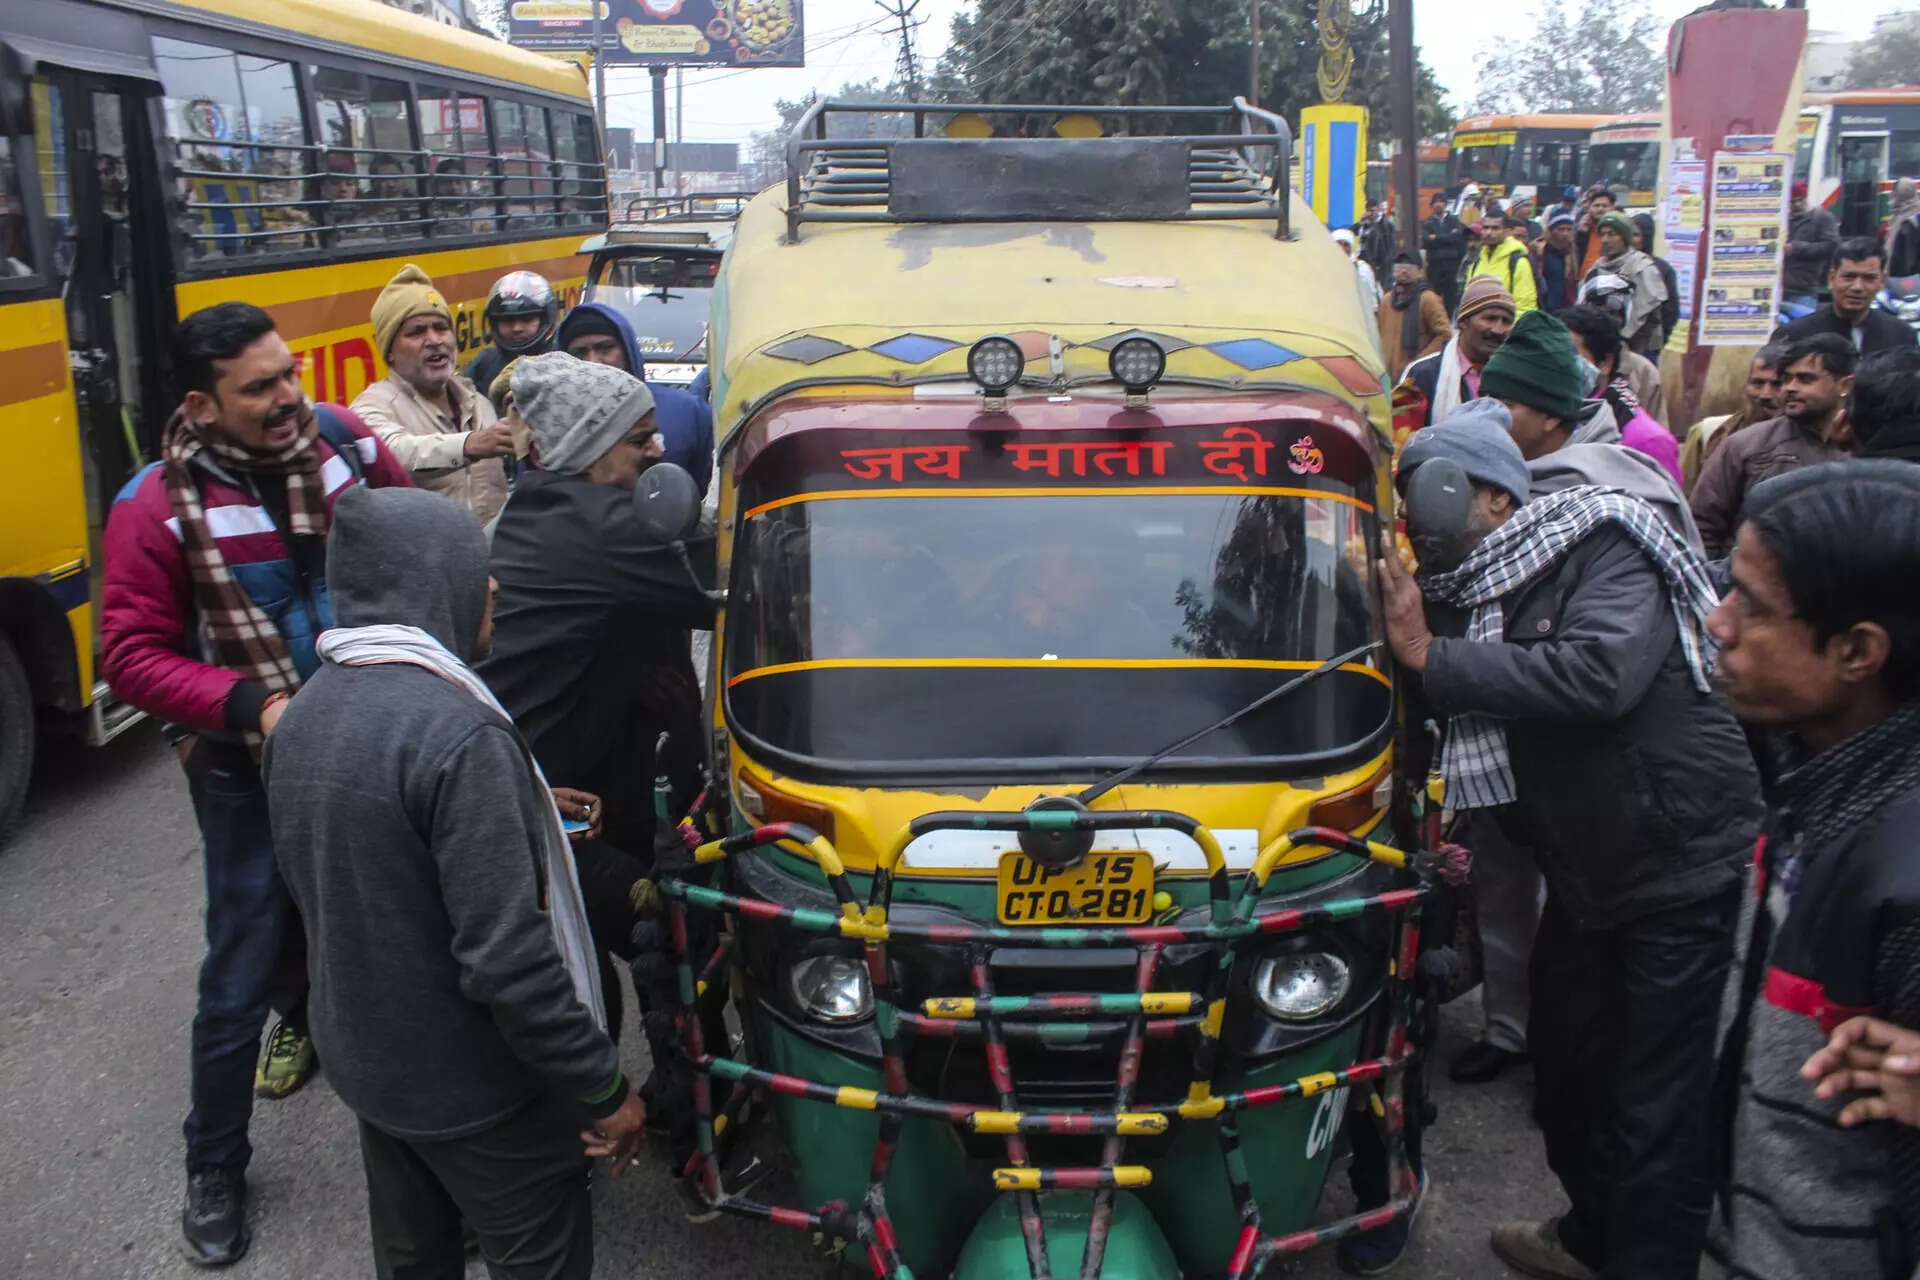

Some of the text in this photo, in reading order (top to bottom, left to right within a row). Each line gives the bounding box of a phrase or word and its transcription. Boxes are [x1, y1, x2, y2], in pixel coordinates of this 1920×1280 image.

[840, 445, 970, 482] जय
[1002, 441, 1175, 477] माता
[1197, 426, 1275, 482] दी
